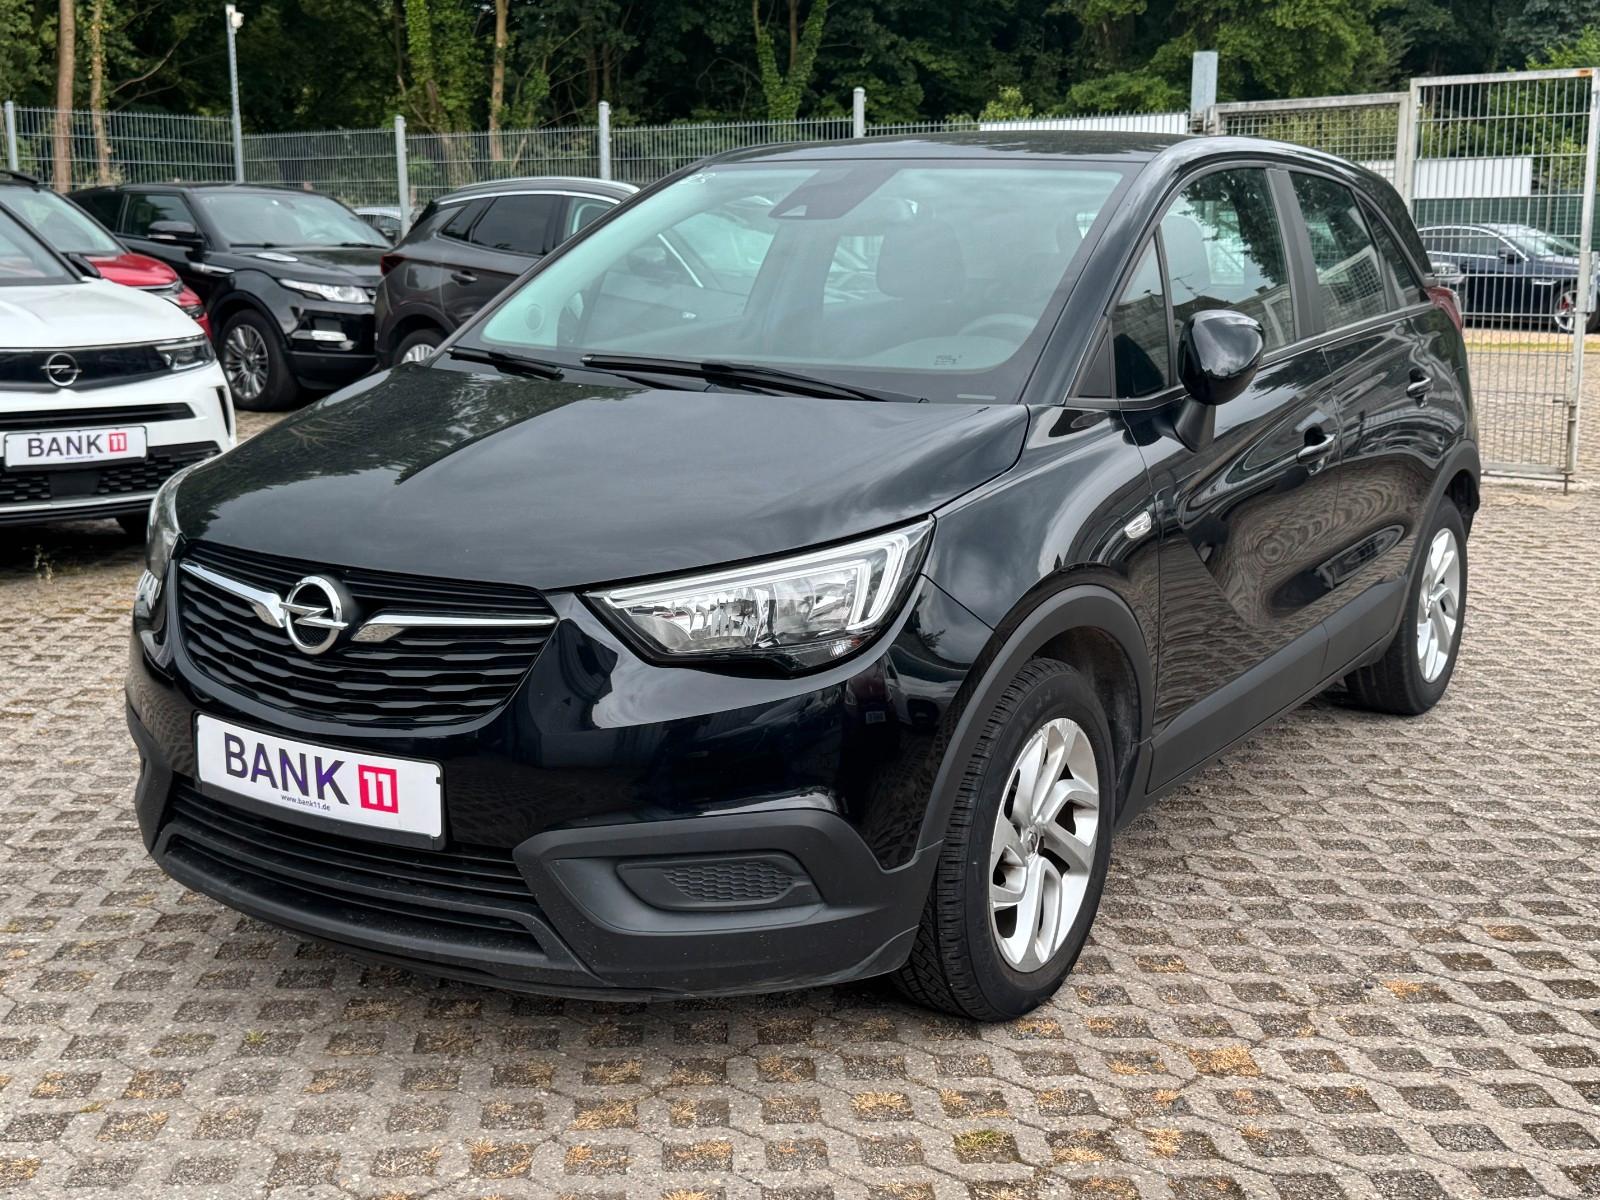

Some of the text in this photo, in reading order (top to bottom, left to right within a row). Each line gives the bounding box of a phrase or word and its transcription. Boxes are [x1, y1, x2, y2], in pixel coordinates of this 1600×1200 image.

[28, 434, 125, 457] BANK 11
[224, 732, 395, 809] BANK 11
[281, 795, 331, 811] www.bank11.de
